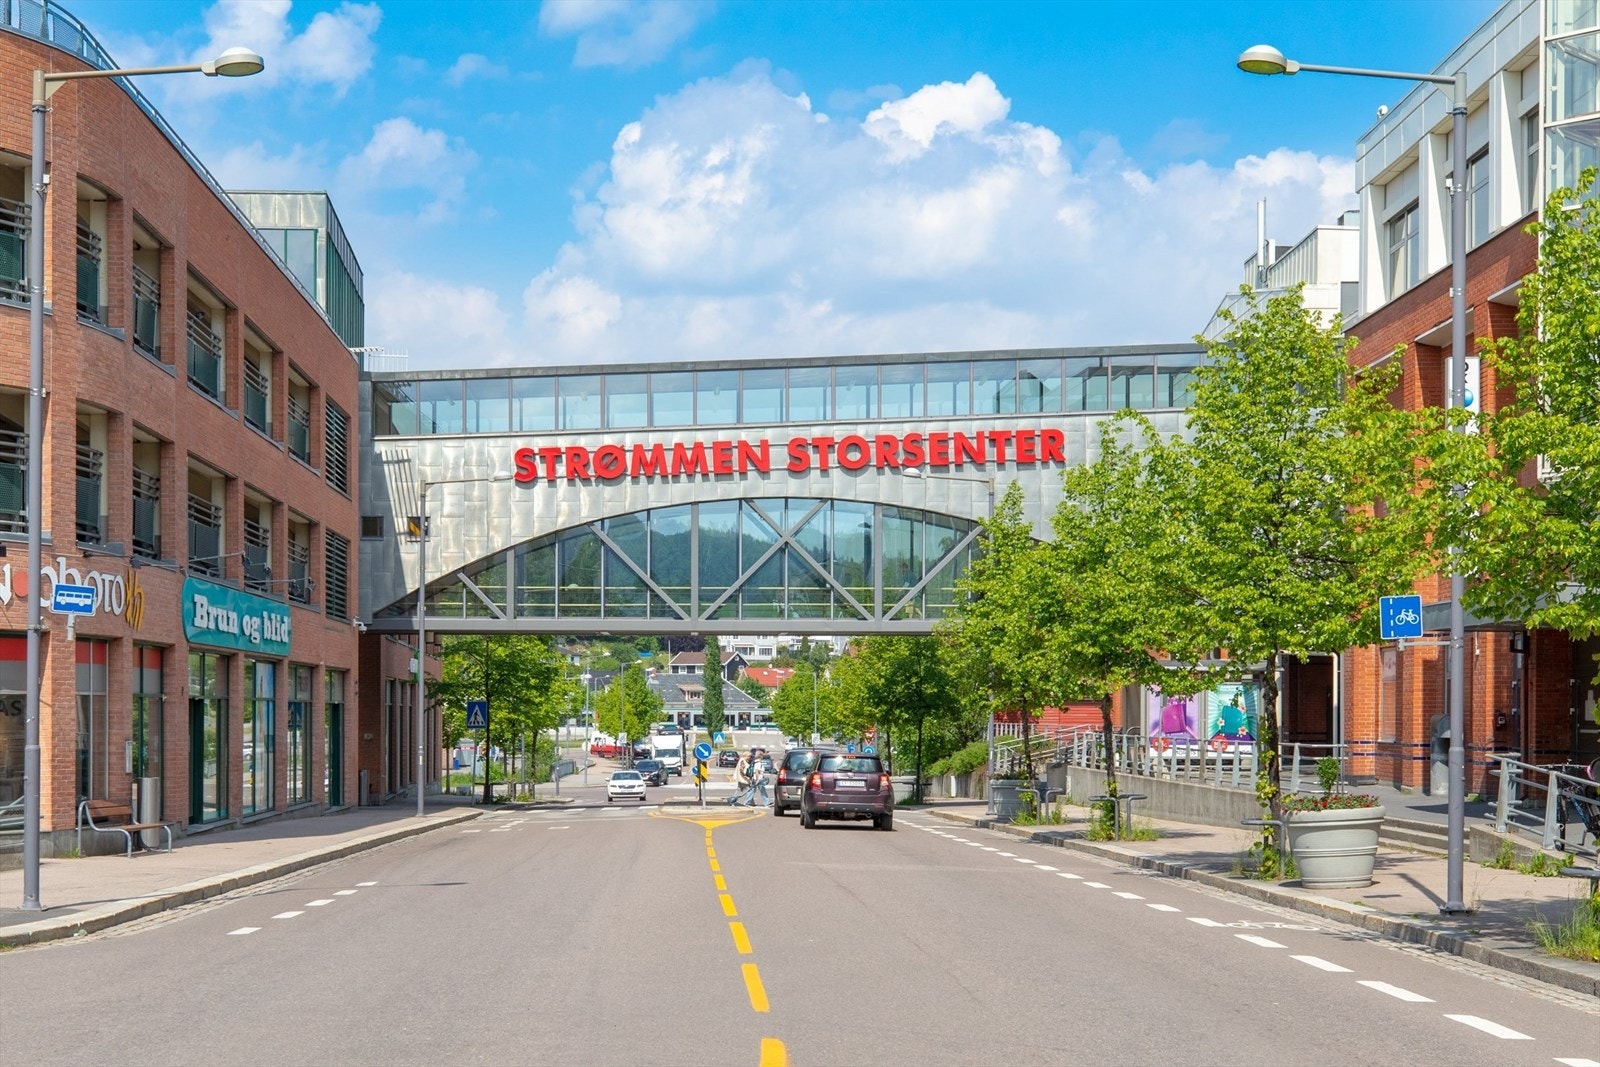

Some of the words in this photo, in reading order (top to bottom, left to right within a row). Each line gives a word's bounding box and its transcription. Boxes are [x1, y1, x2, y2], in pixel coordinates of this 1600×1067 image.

[514, 439, 770, 483] STRØMMEN
[787, 429, 1066, 472] STORSENTER
[194, 593, 238, 634] Brun
[242, 614, 260, 644] og
[262, 611, 289, 643] blid
